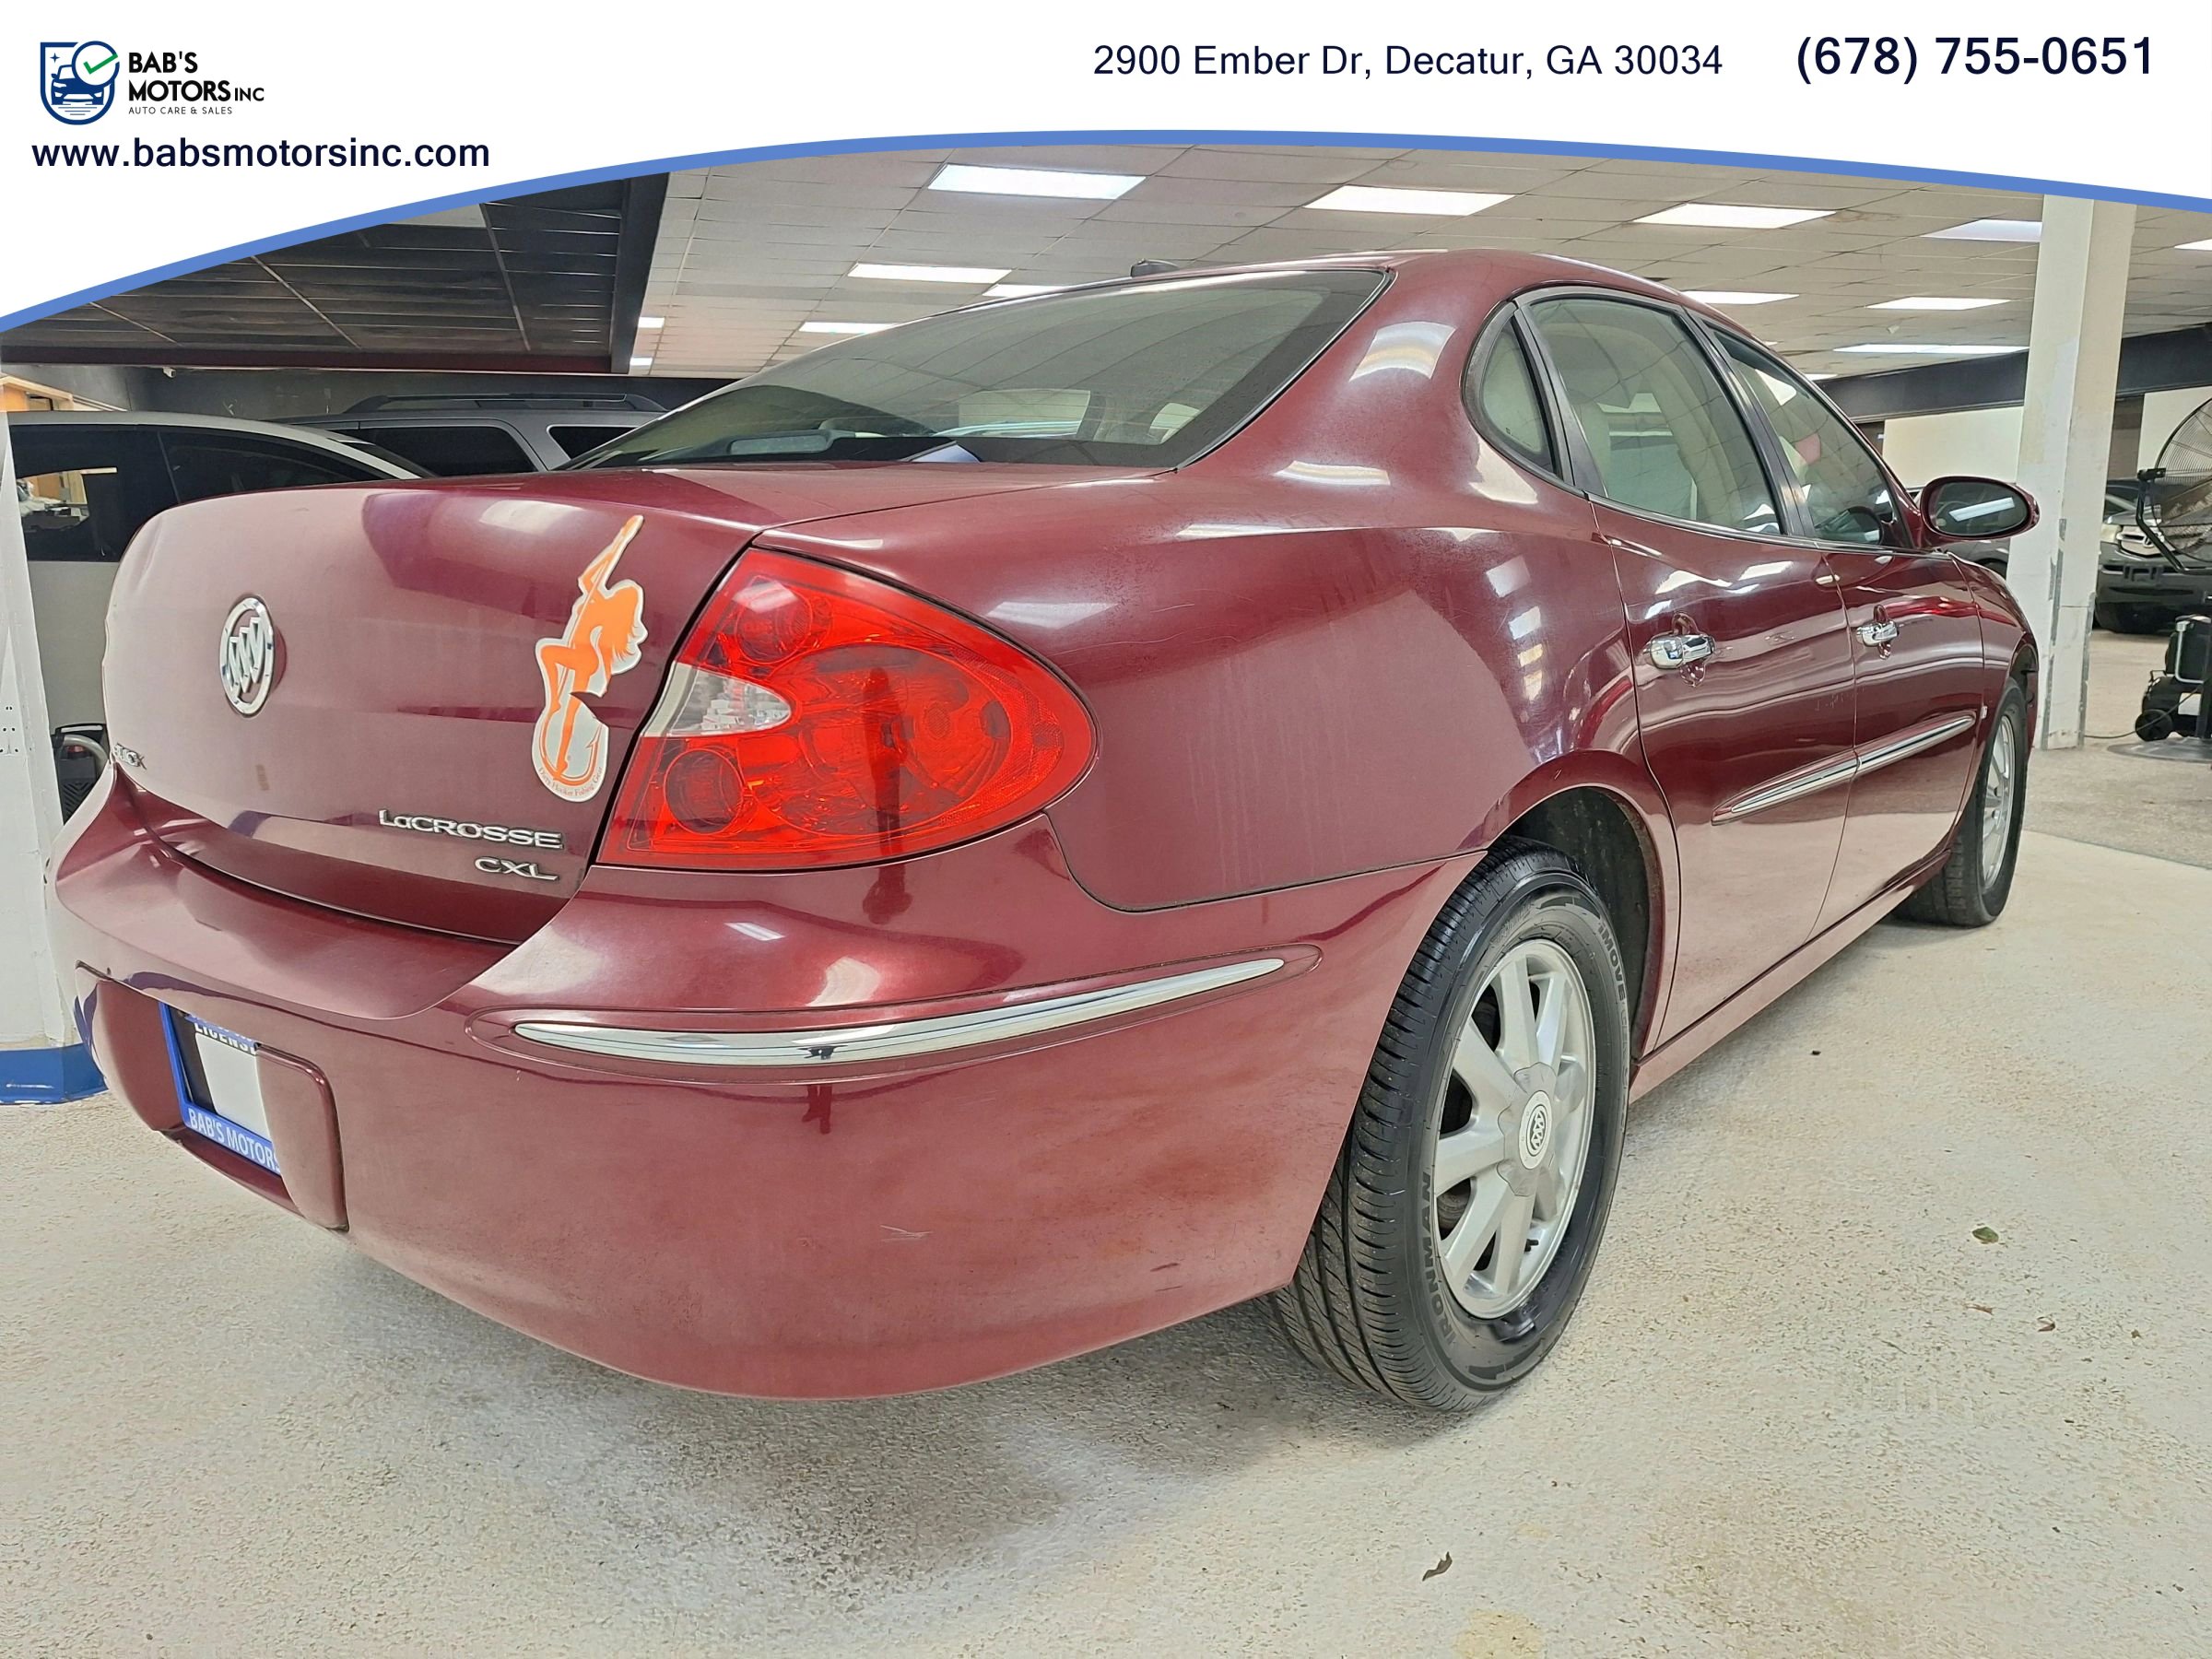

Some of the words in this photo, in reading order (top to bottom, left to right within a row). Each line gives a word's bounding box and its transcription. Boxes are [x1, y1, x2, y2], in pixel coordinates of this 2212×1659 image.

[474, 856, 559, 881] CXL
[188, 1108, 225, 1143] BAB'S
[1422, 1171, 1456, 1346] IRONMAN
